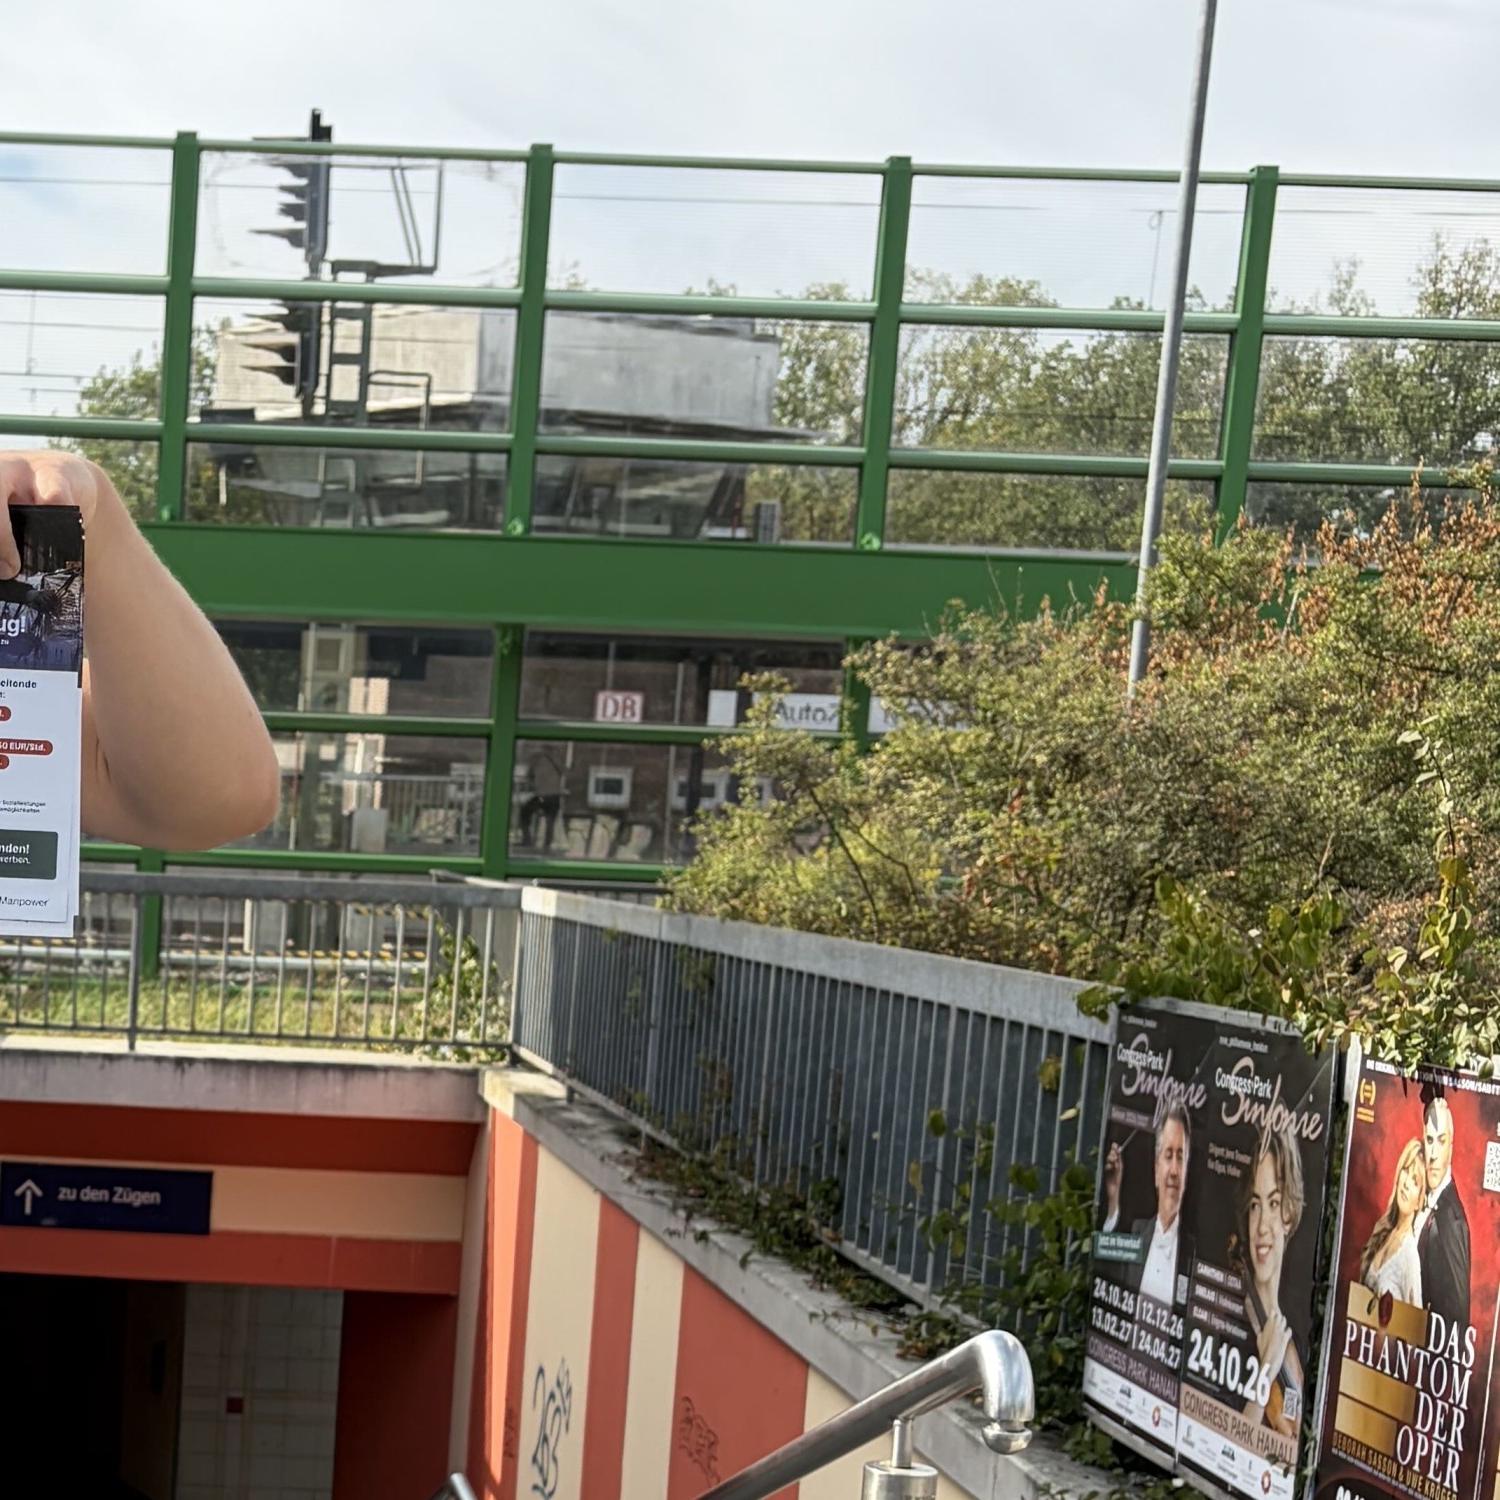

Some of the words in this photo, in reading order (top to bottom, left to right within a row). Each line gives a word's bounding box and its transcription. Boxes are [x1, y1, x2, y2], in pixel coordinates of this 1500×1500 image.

[602, 697, 636, 719] DB
[0, 896, 48, 908] Manpower
[1117, 1043, 1147, 1070] Congress
[1148, 1053, 1164, 1071] Park
[1121, 1033, 1207, 1129] Sinfonie
[1215, 1067, 1252, 1097] Congress
[1252, 1074, 1272, 1099] Park
[1221, 1056, 1324, 1161] Sinfonie
[57, 1187, 76, 1200] zu
[79, 1185, 109, 1202] den
[112, 1186, 161, 1208] Zügen
[1091, 1305, 1132, 1344] 13.02.27
[1138, 1329, 1181, 1369] 24.04.27
[1093, 1276, 1134, 1315] 24.10.26
[1141, 1300, 1184, 1340] 12.12.26
[1428, 1311, 1477, 1368] DAS
[1088, 1336, 1126, 1373] CONGRESS
[1128, 1357, 1148, 1385] PARK
[1149, 1368, 1179, 1400] HANAU
[1187, 1327, 1271, 1408] 24.10.26
[1343, 1319, 1473, 1411] PHANTOM
[1184, 1390, 1229, 1433] CONGRESS
[1231, 1416, 1256, 1447] PARK
[1256, 1429, 1293, 1464] HANAU
[1415, 1391, 1466, 1451] DER
[1332, 1431, 1367, 1461] DEBORAH
[1367, 1448, 1397, 1477] SASSON
[1398, 1465, 1404, 1481] &
[1406, 1469, 1423, 1491] UWE
[1396, 1424, 1461, 1492] OPER
